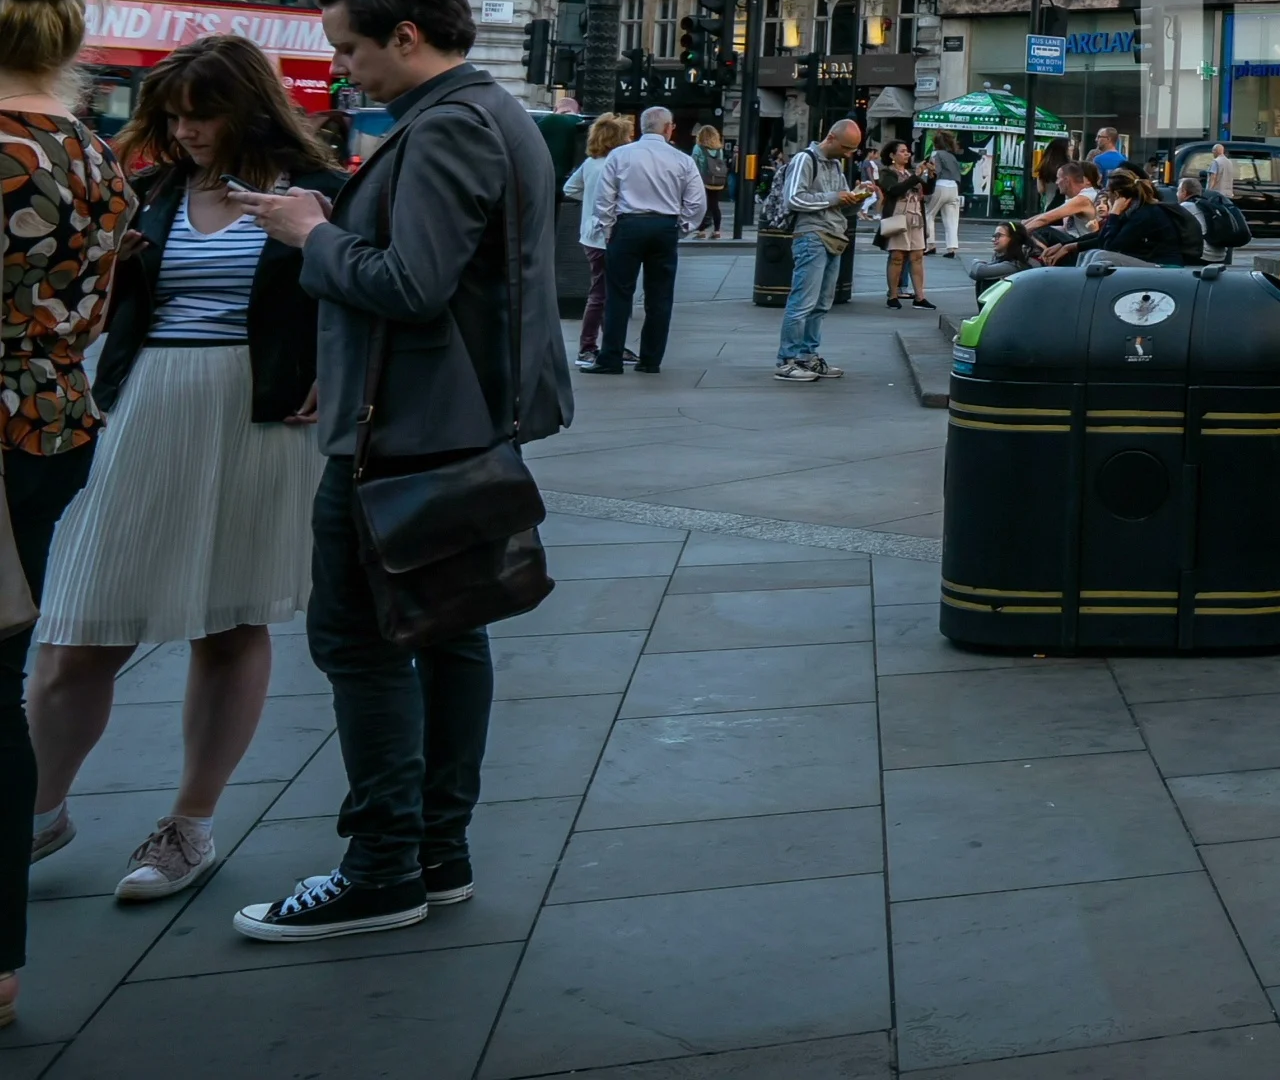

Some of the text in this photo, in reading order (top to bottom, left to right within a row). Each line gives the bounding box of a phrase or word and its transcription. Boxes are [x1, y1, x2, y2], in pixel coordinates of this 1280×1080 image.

[85, 3, 152, 39] AND
[230, 13, 336, 51] SUMM
[1031, 37, 1061, 46] BUS LANE
[1028, 57, 1062, 66] LOOK BOTH
